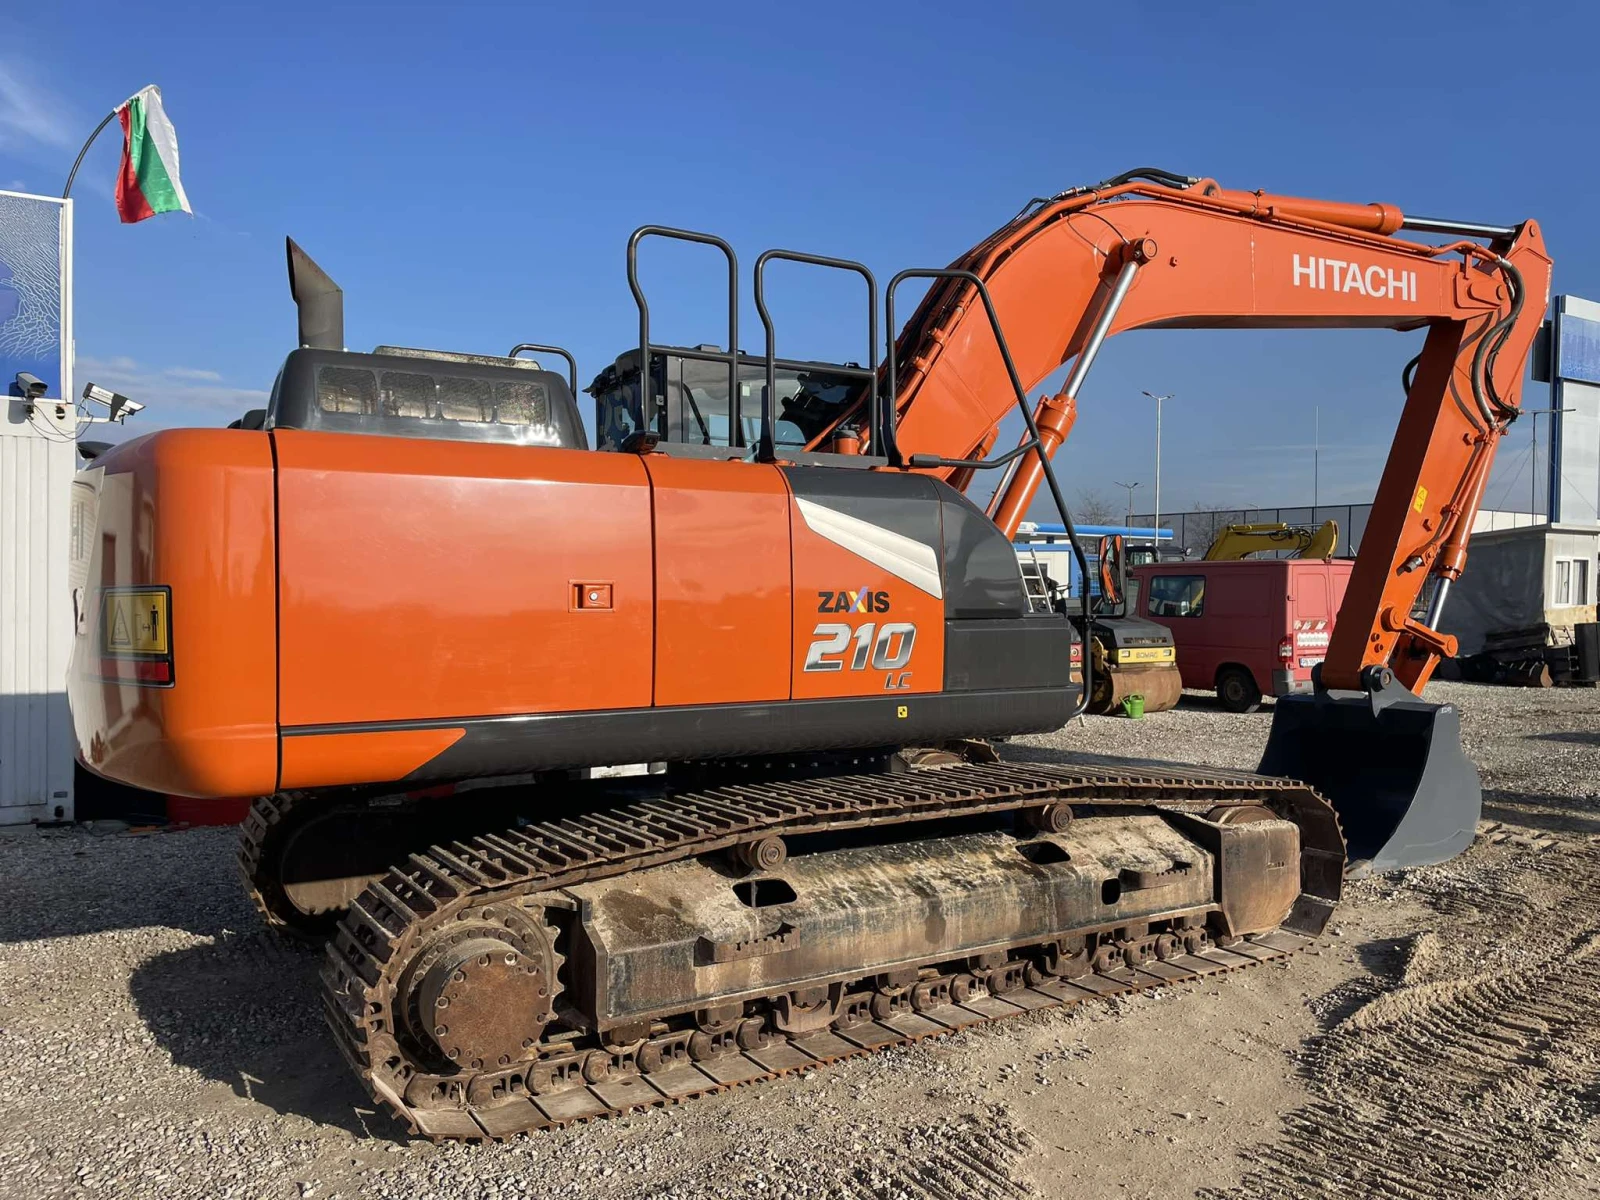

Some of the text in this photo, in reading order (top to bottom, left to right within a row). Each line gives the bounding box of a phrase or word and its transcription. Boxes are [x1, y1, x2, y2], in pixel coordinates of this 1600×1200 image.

[1293, 254, 1417, 302] HITACHI
[818, 586, 890, 613] ZAXIS
[804, 622, 917, 672] 210
[884, 672, 912, 689] LC
